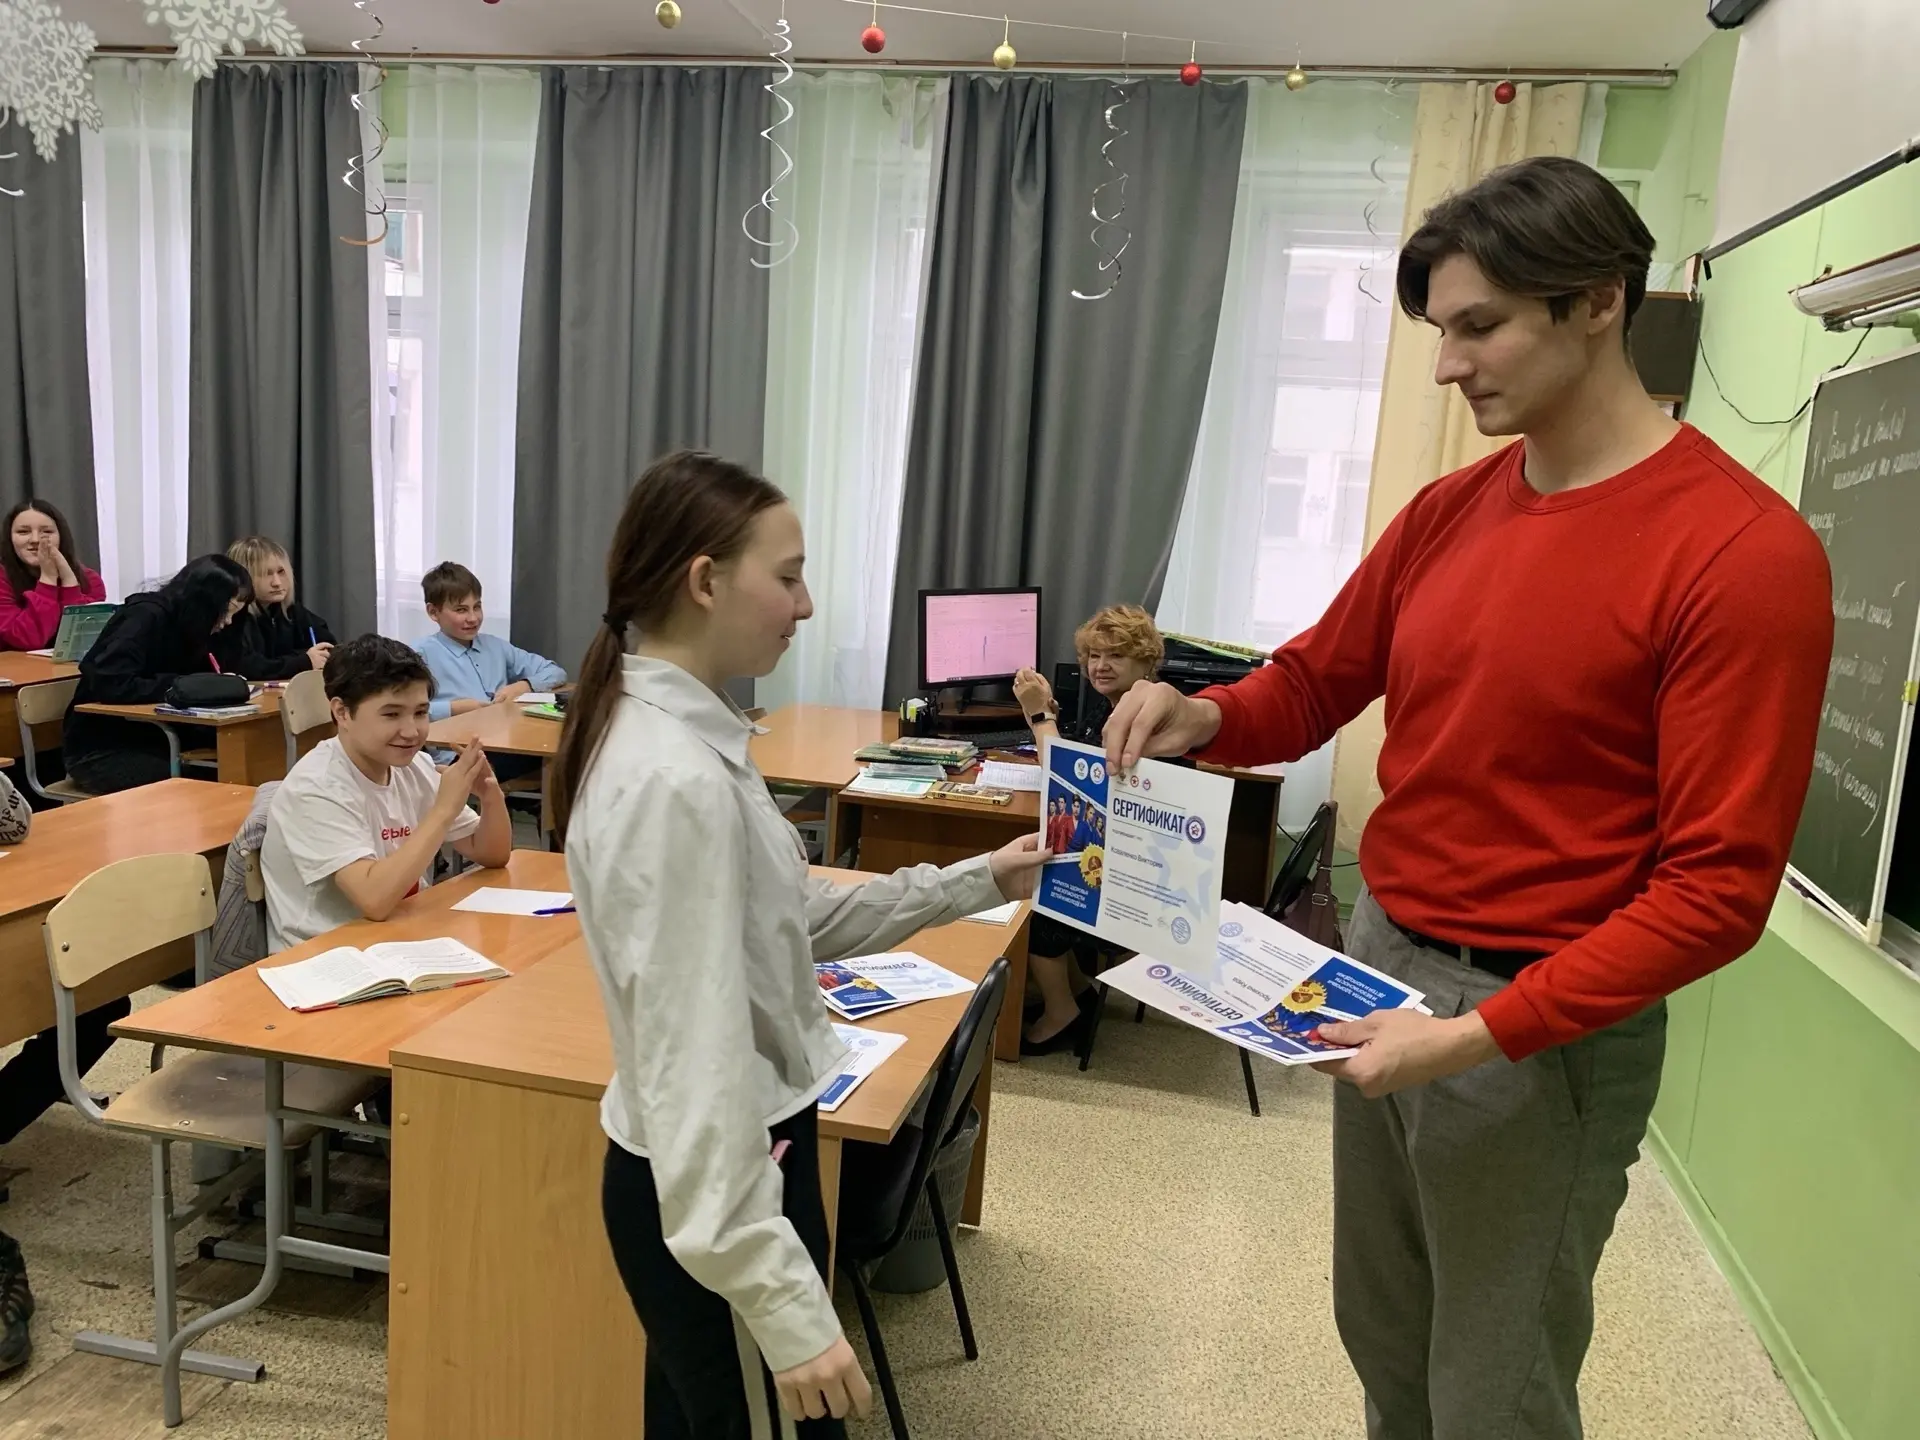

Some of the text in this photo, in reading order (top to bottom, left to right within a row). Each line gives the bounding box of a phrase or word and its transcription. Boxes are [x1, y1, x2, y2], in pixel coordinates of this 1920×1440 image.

[1113, 797, 1185, 834] СЕРТИФИКАТ
[1138, 854, 1163, 869] Виктория
[1232, 977, 1247, 989] Кира
[1327, 980, 1377, 1007] ФОРМУЛА ЗДОРОВЬЯ
[1163, 976, 1243, 1020] СЕРТИФИКАТ
